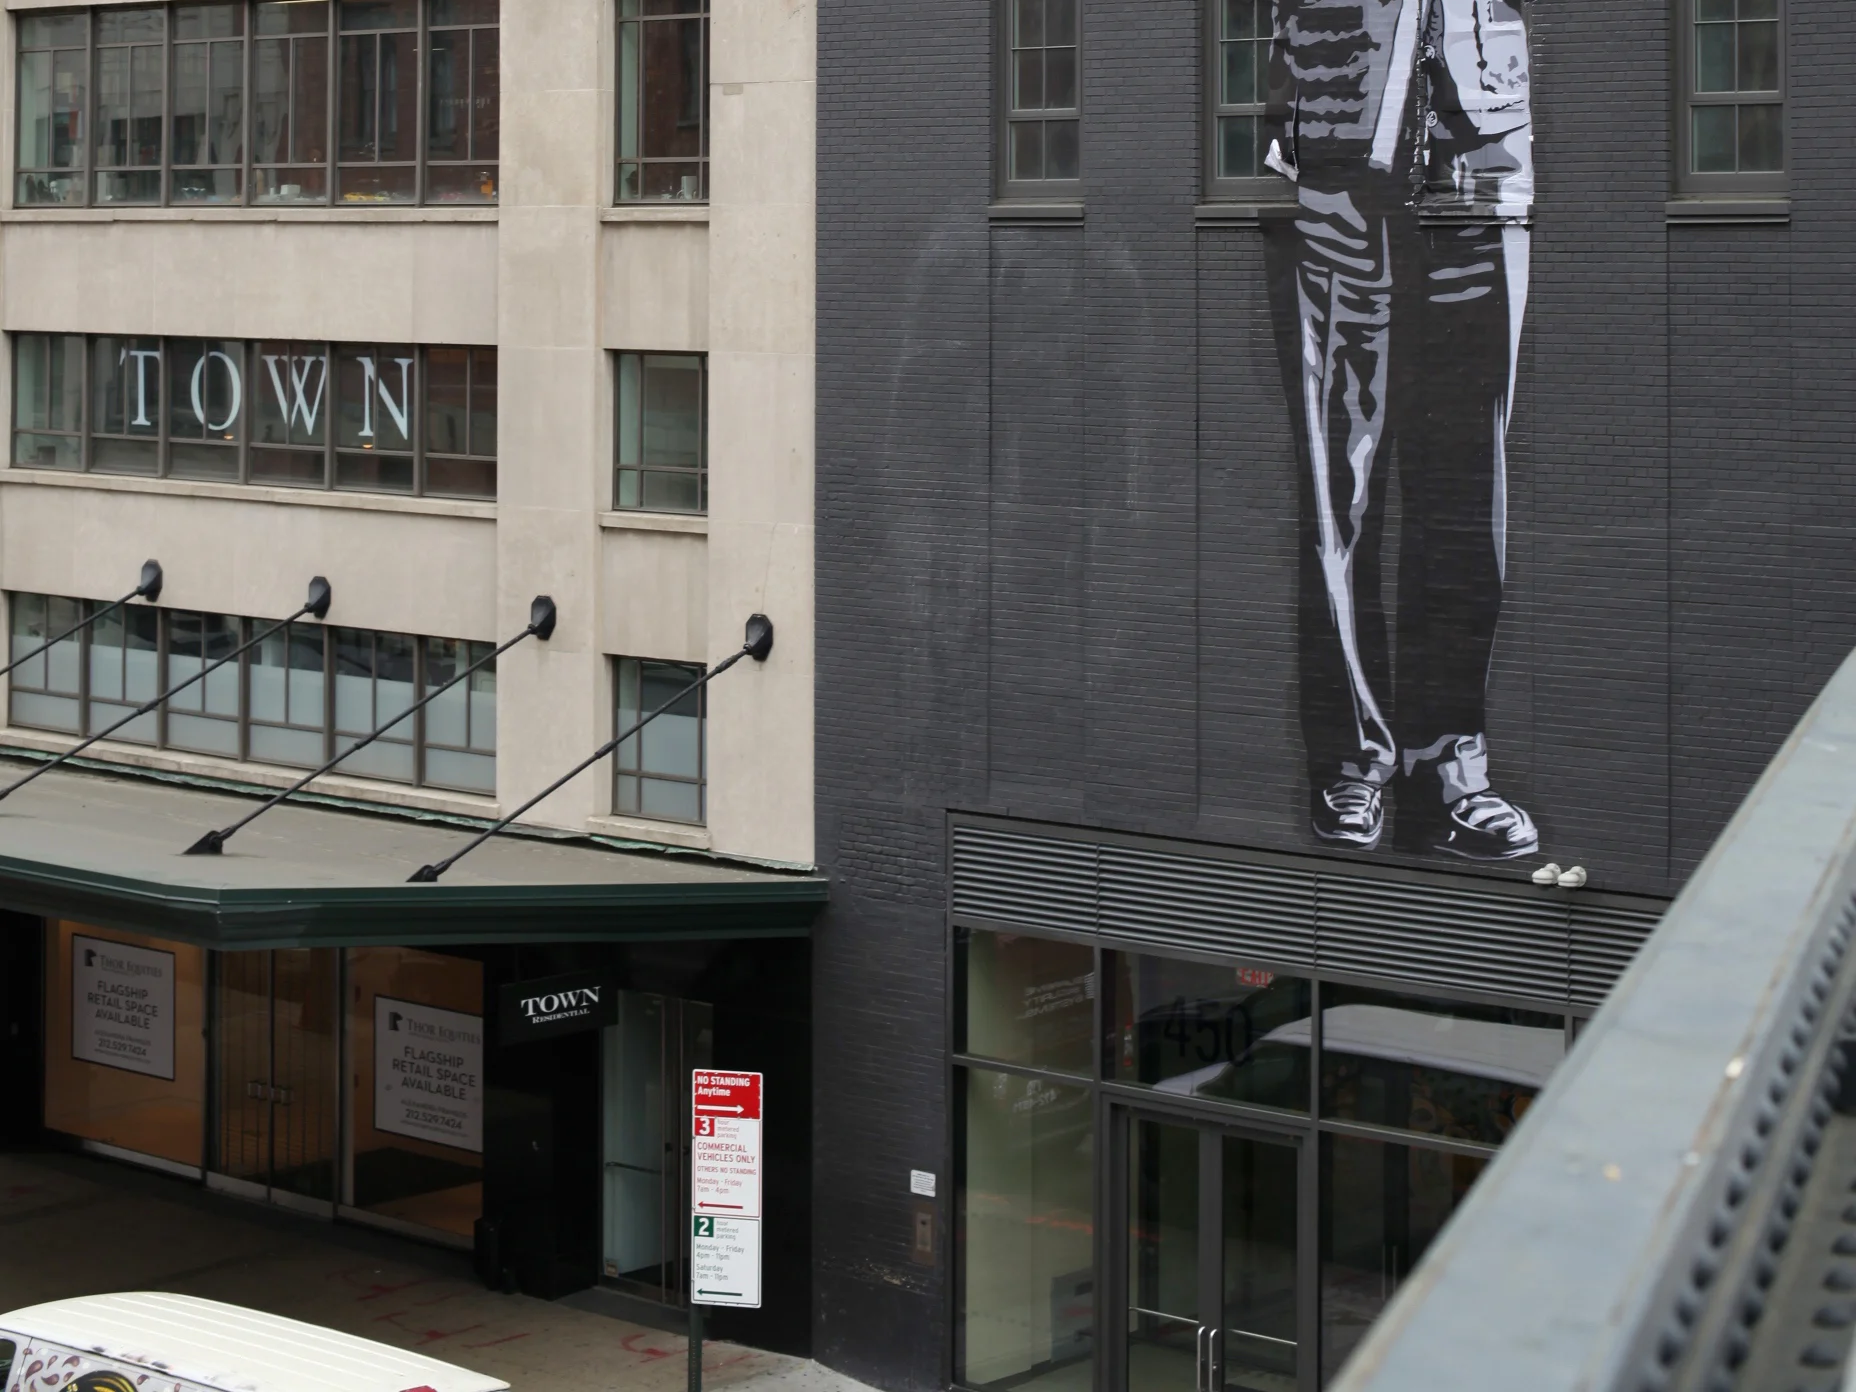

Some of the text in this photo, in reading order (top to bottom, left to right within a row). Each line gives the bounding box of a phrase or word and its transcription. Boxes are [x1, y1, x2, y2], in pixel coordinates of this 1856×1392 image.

[120, 347, 414, 440] TOWN
[97, 980, 149, 1000] FLAGSHIP
[87, 992, 159, 1018] RETAIL SPACE
[521, 986, 602, 1017] TOWN
[95, 1009, 151, 1029] AVAILABLE
[532, 1008, 591, 1024] RESIDENTIAL
[406, 1018, 436, 1037] THOR
[1163, 995, 1254, 1067] 450
[404, 1046, 464, 1069] FLAGSHIP
[392, 1058, 477, 1088] RETAIL SPACE
[697, 1075, 751, 1087] NO STANDING
[401, 1076, 467, 1100] AVAILABLE
[697, 1086, 731, 1098] Anytime
[699, 1115, 711, 1135] 3
[697, 1141, 748, 1153] COMMERCIAL
[697, 1152, 756, 1164] VEHICLES ONLY
[697, 1165, 757, 1176] OTHERS NO STANDING
[697, 1177, 719, 1186] Monday
[725, 1178, 742, 1187] Friday
[698, 1217, 710, 1236] 2
[696, 1243, 720, 1252] Monday
[726, 1244, 745, 1254] Friday
[696, 1251, 710, 1260] 4pm
[696, 1263, 724, 1273] Saturday
[696, 1272, 709, 1280] 7am
